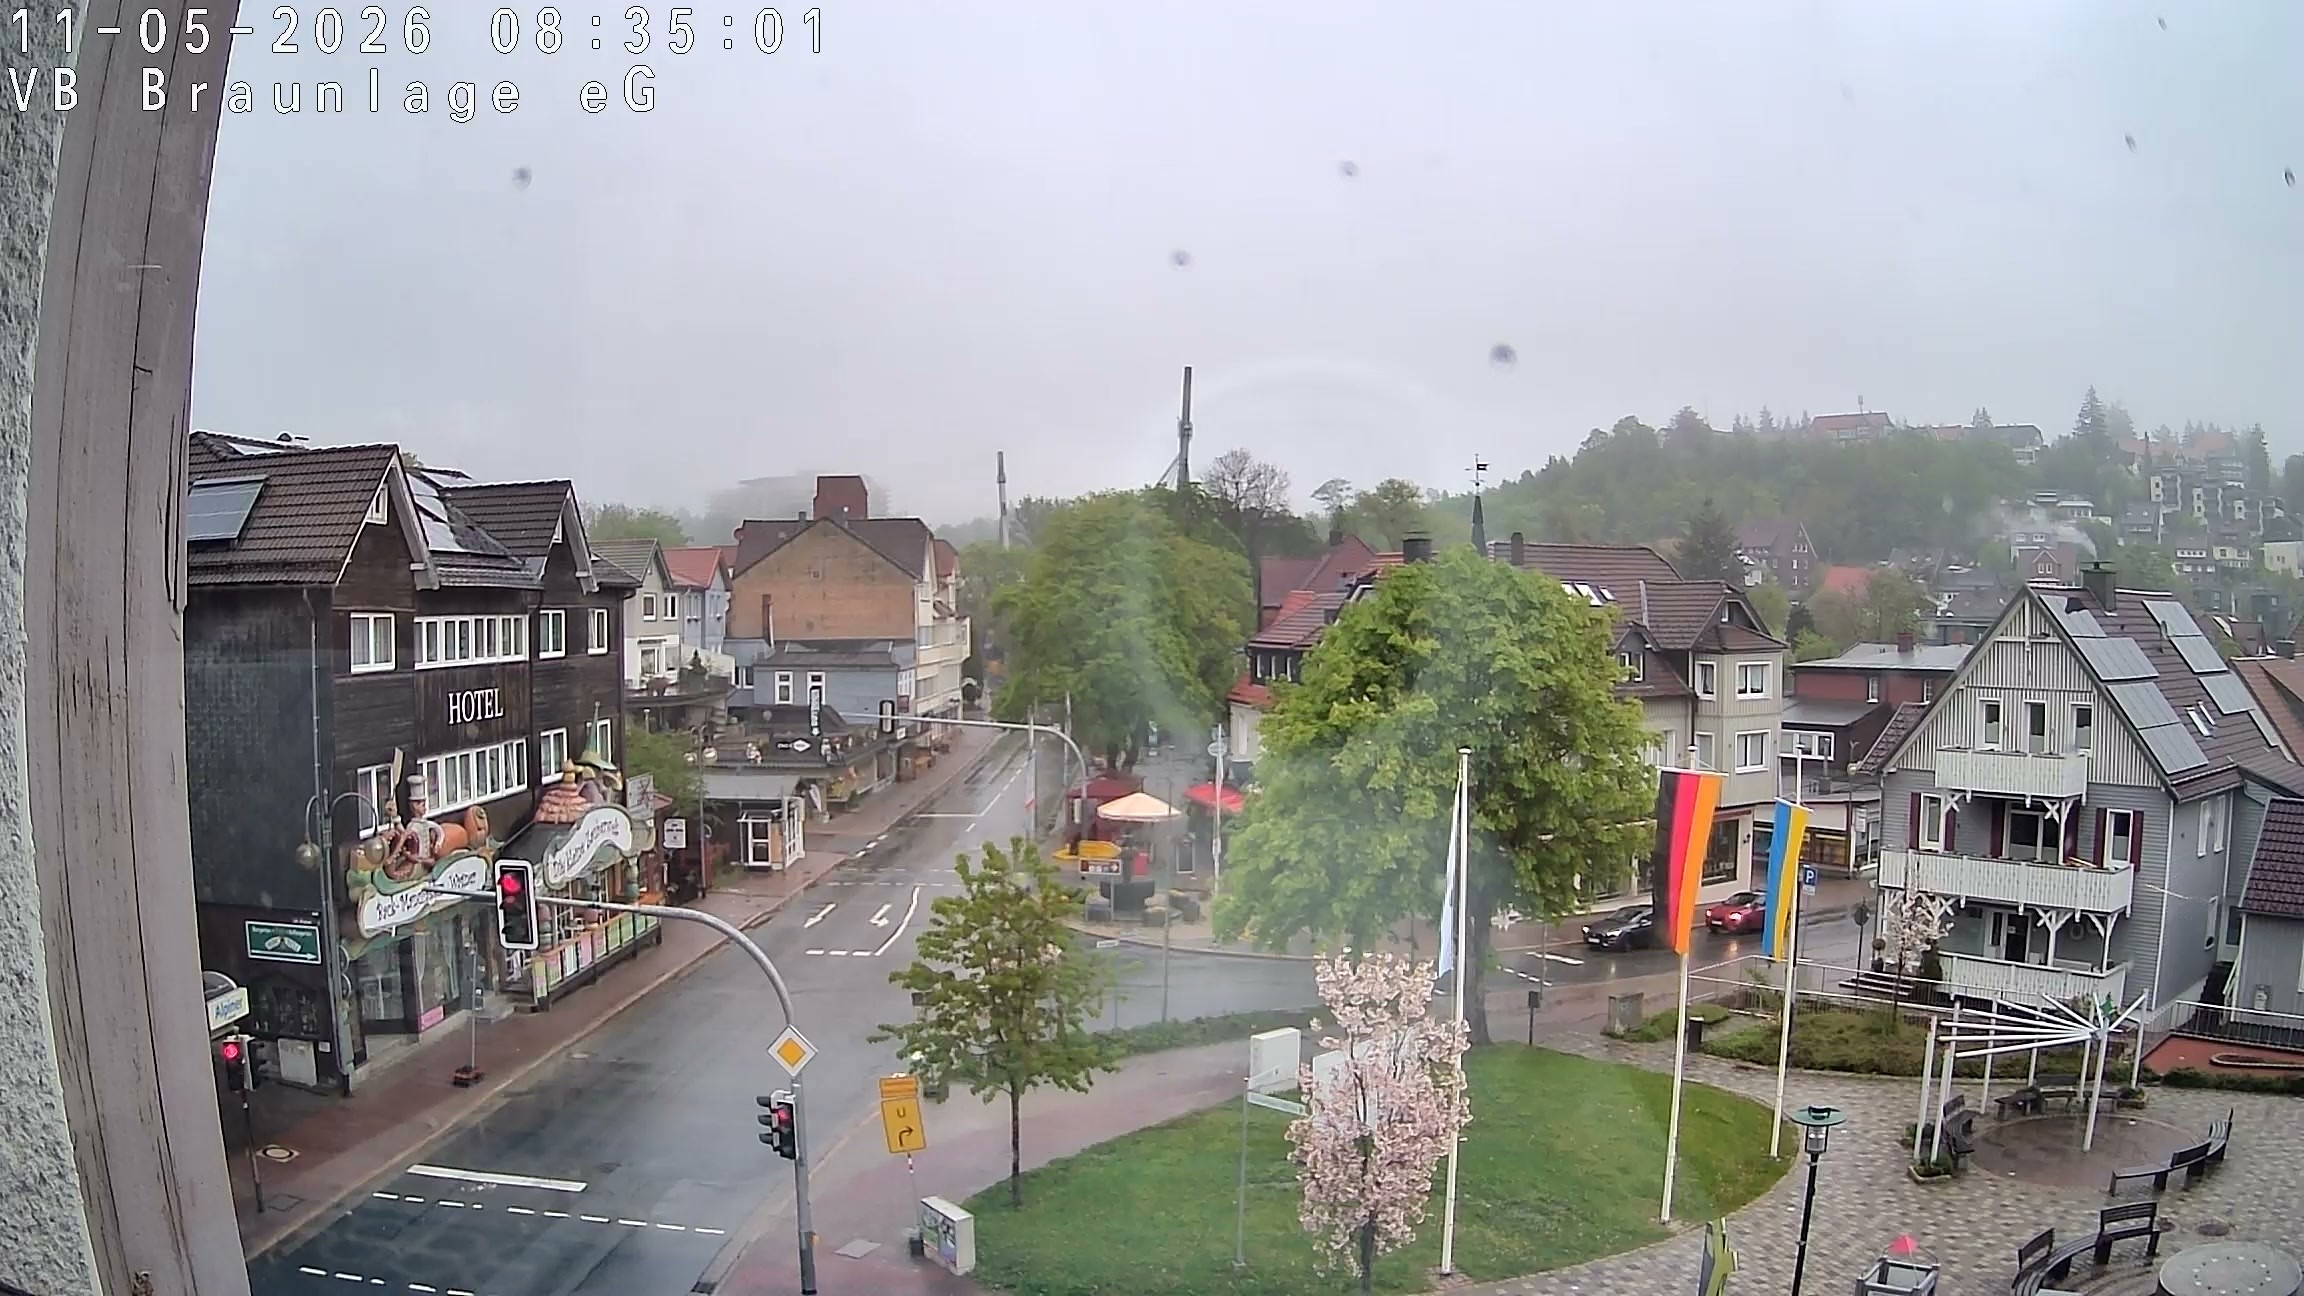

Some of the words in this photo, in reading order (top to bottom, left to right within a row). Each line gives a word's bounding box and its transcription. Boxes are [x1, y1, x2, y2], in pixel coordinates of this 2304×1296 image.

[448, 688, 504, 725] HOTEL
[1805, 870, 1814, 883] P
[896, 1106, 906, 1118] U
